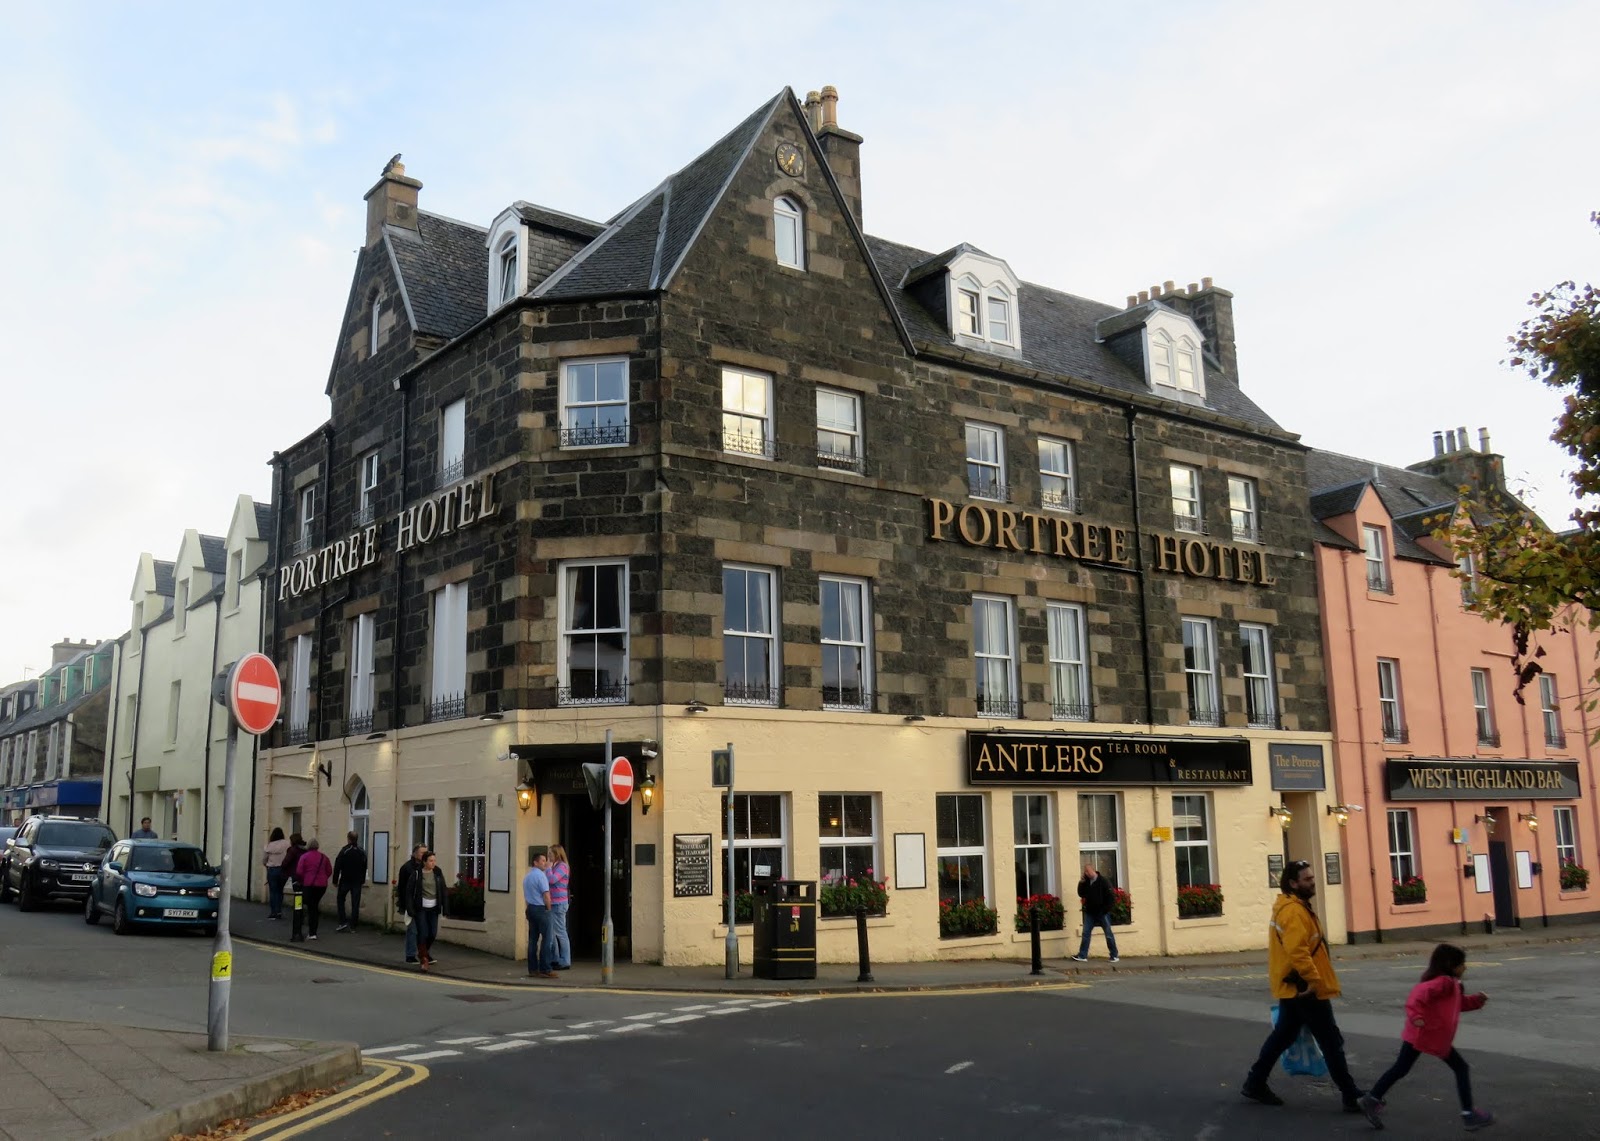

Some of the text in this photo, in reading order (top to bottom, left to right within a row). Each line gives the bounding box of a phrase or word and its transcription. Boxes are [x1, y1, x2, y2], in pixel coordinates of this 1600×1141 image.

[278, 472, 500, 601] PORTREE HOTEL
[928, 497, 1276, 587] PORTREE HOTEL
[1107, 742, 1168, 755] TEA ROOM
[975, 742, 1104, 774] ANTLERS
[1169, 758, 1177, 768] &
[1273, 754, 1321, 768] The Portree
[1178, 769, 1248, 780] RESTAURANT
[1408, 768, 1564, 790] WEST HIGHLAND BAR
